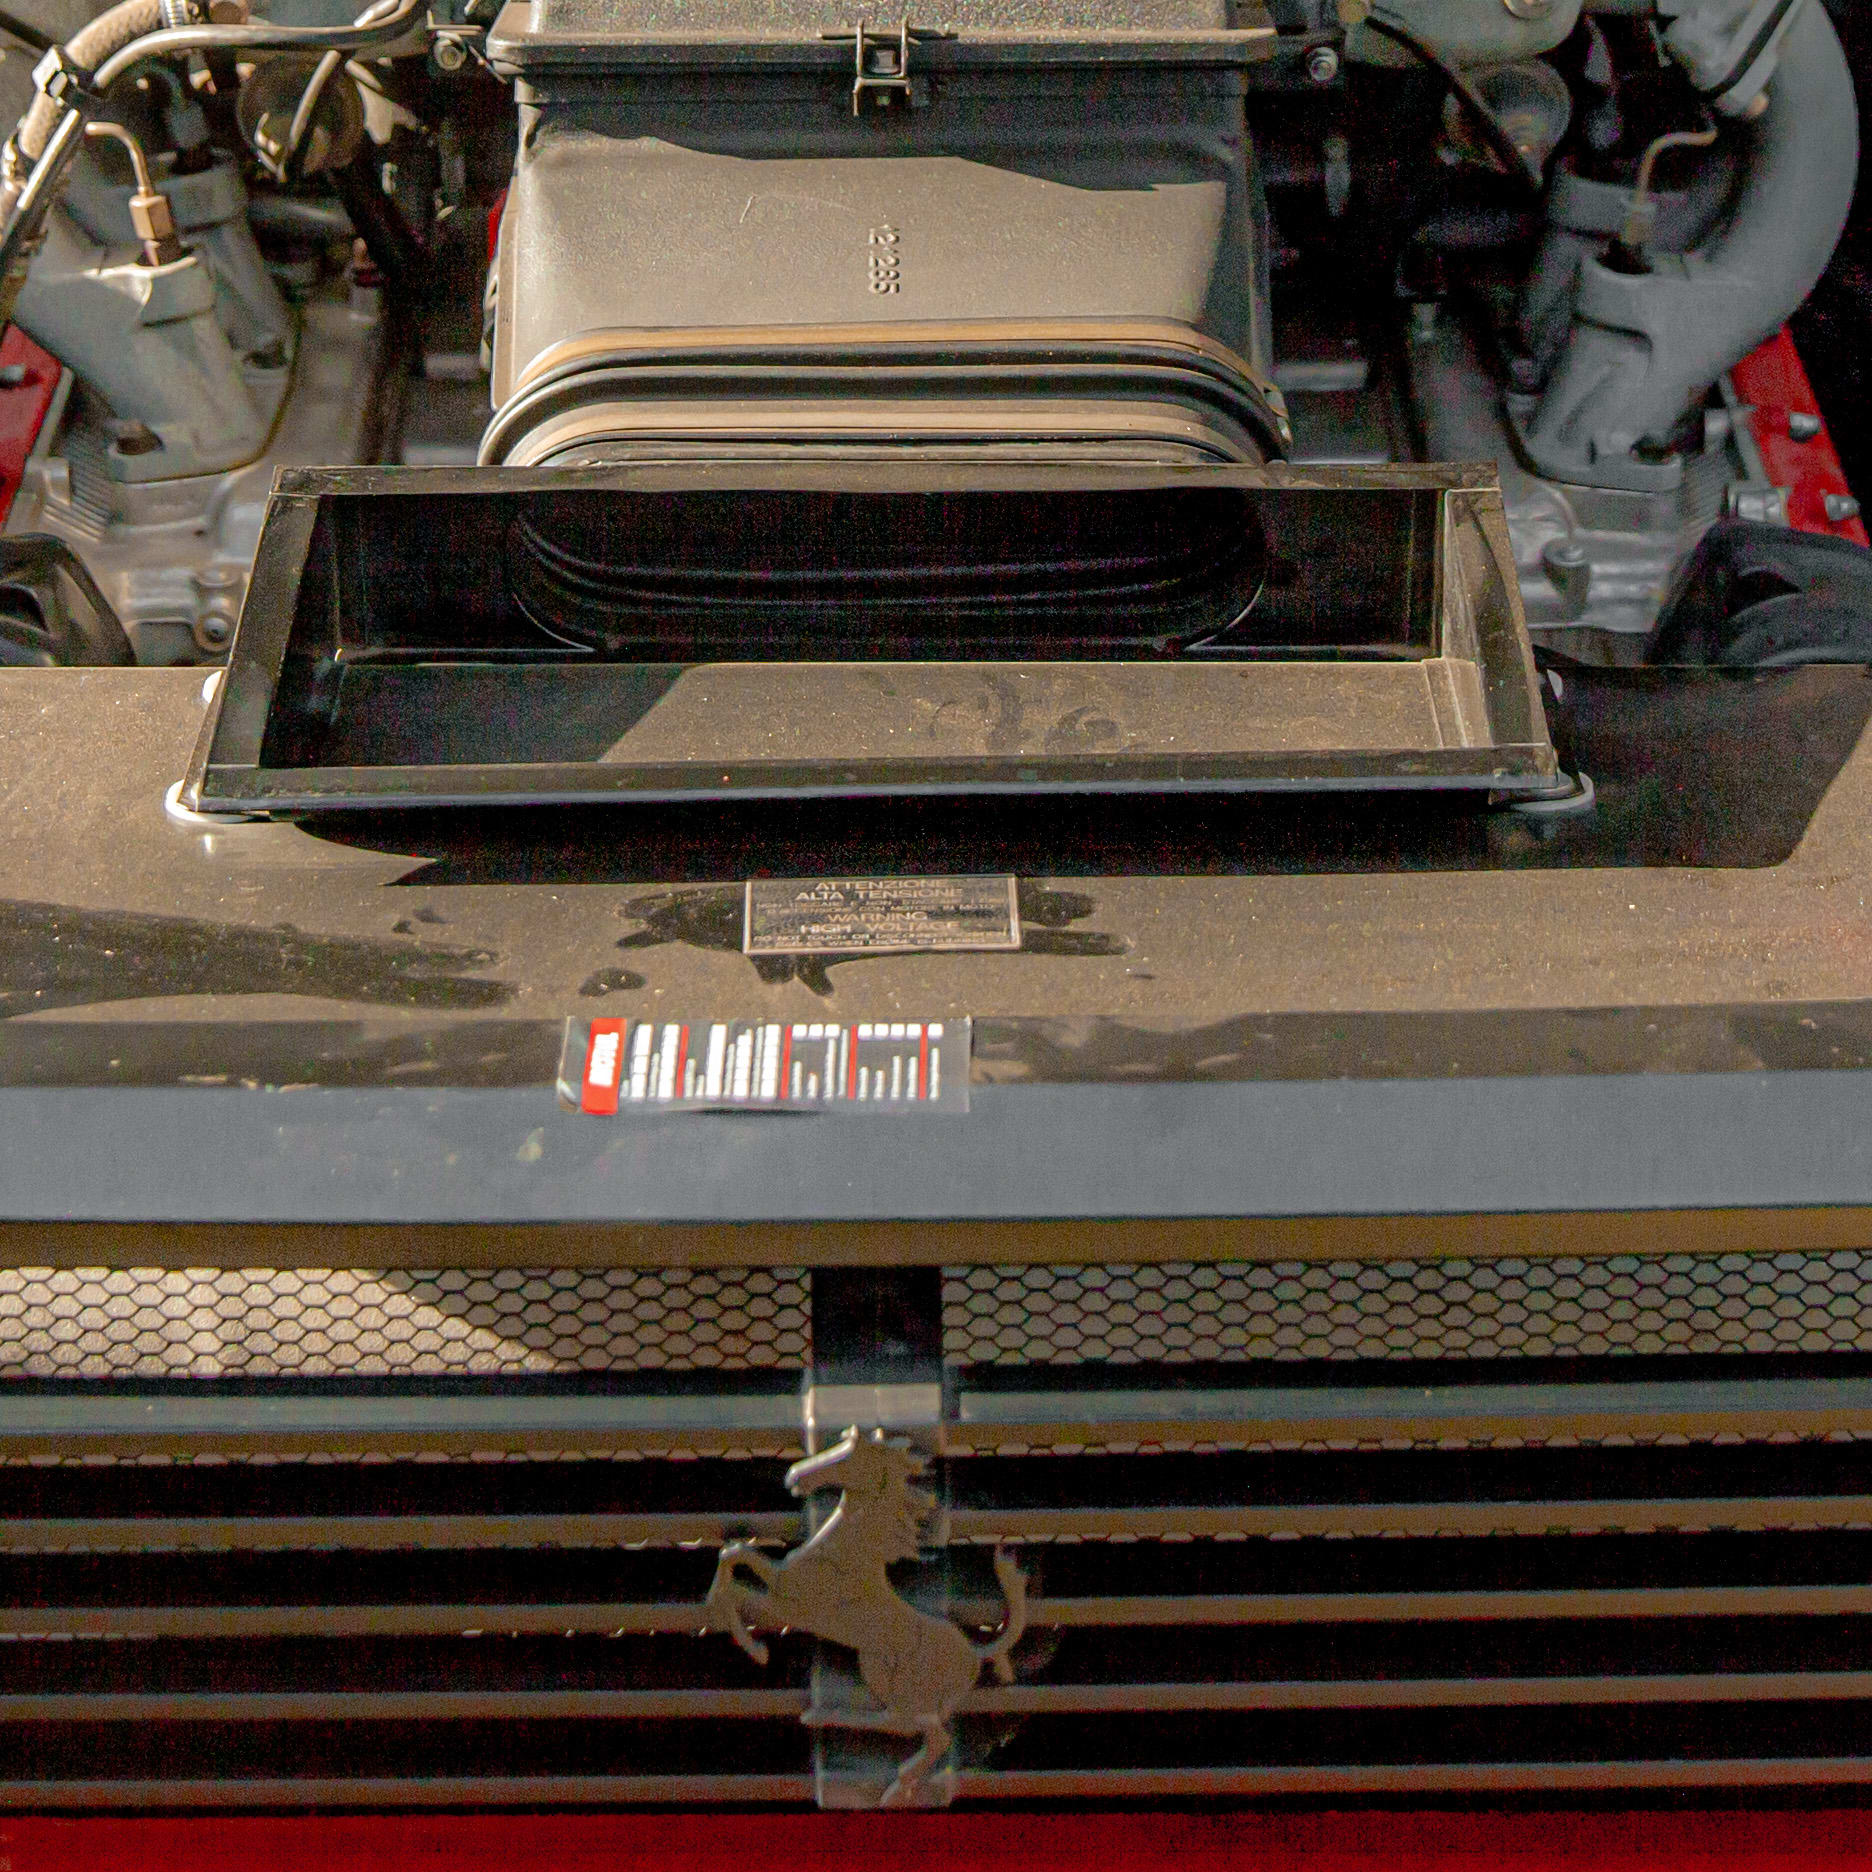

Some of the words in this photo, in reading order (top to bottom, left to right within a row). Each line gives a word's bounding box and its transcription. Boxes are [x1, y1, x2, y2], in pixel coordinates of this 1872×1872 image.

[815, 879, 949, 891] ATTENZIONE
[795, 891, 844, 901] ALTA
[855, 888, 963, 899] TENSIONE
[827, 912, 928, 922] WARNING
[800, 923, 851, 934] HIGH
[866, 921, 960, 932] VOLTAGE
